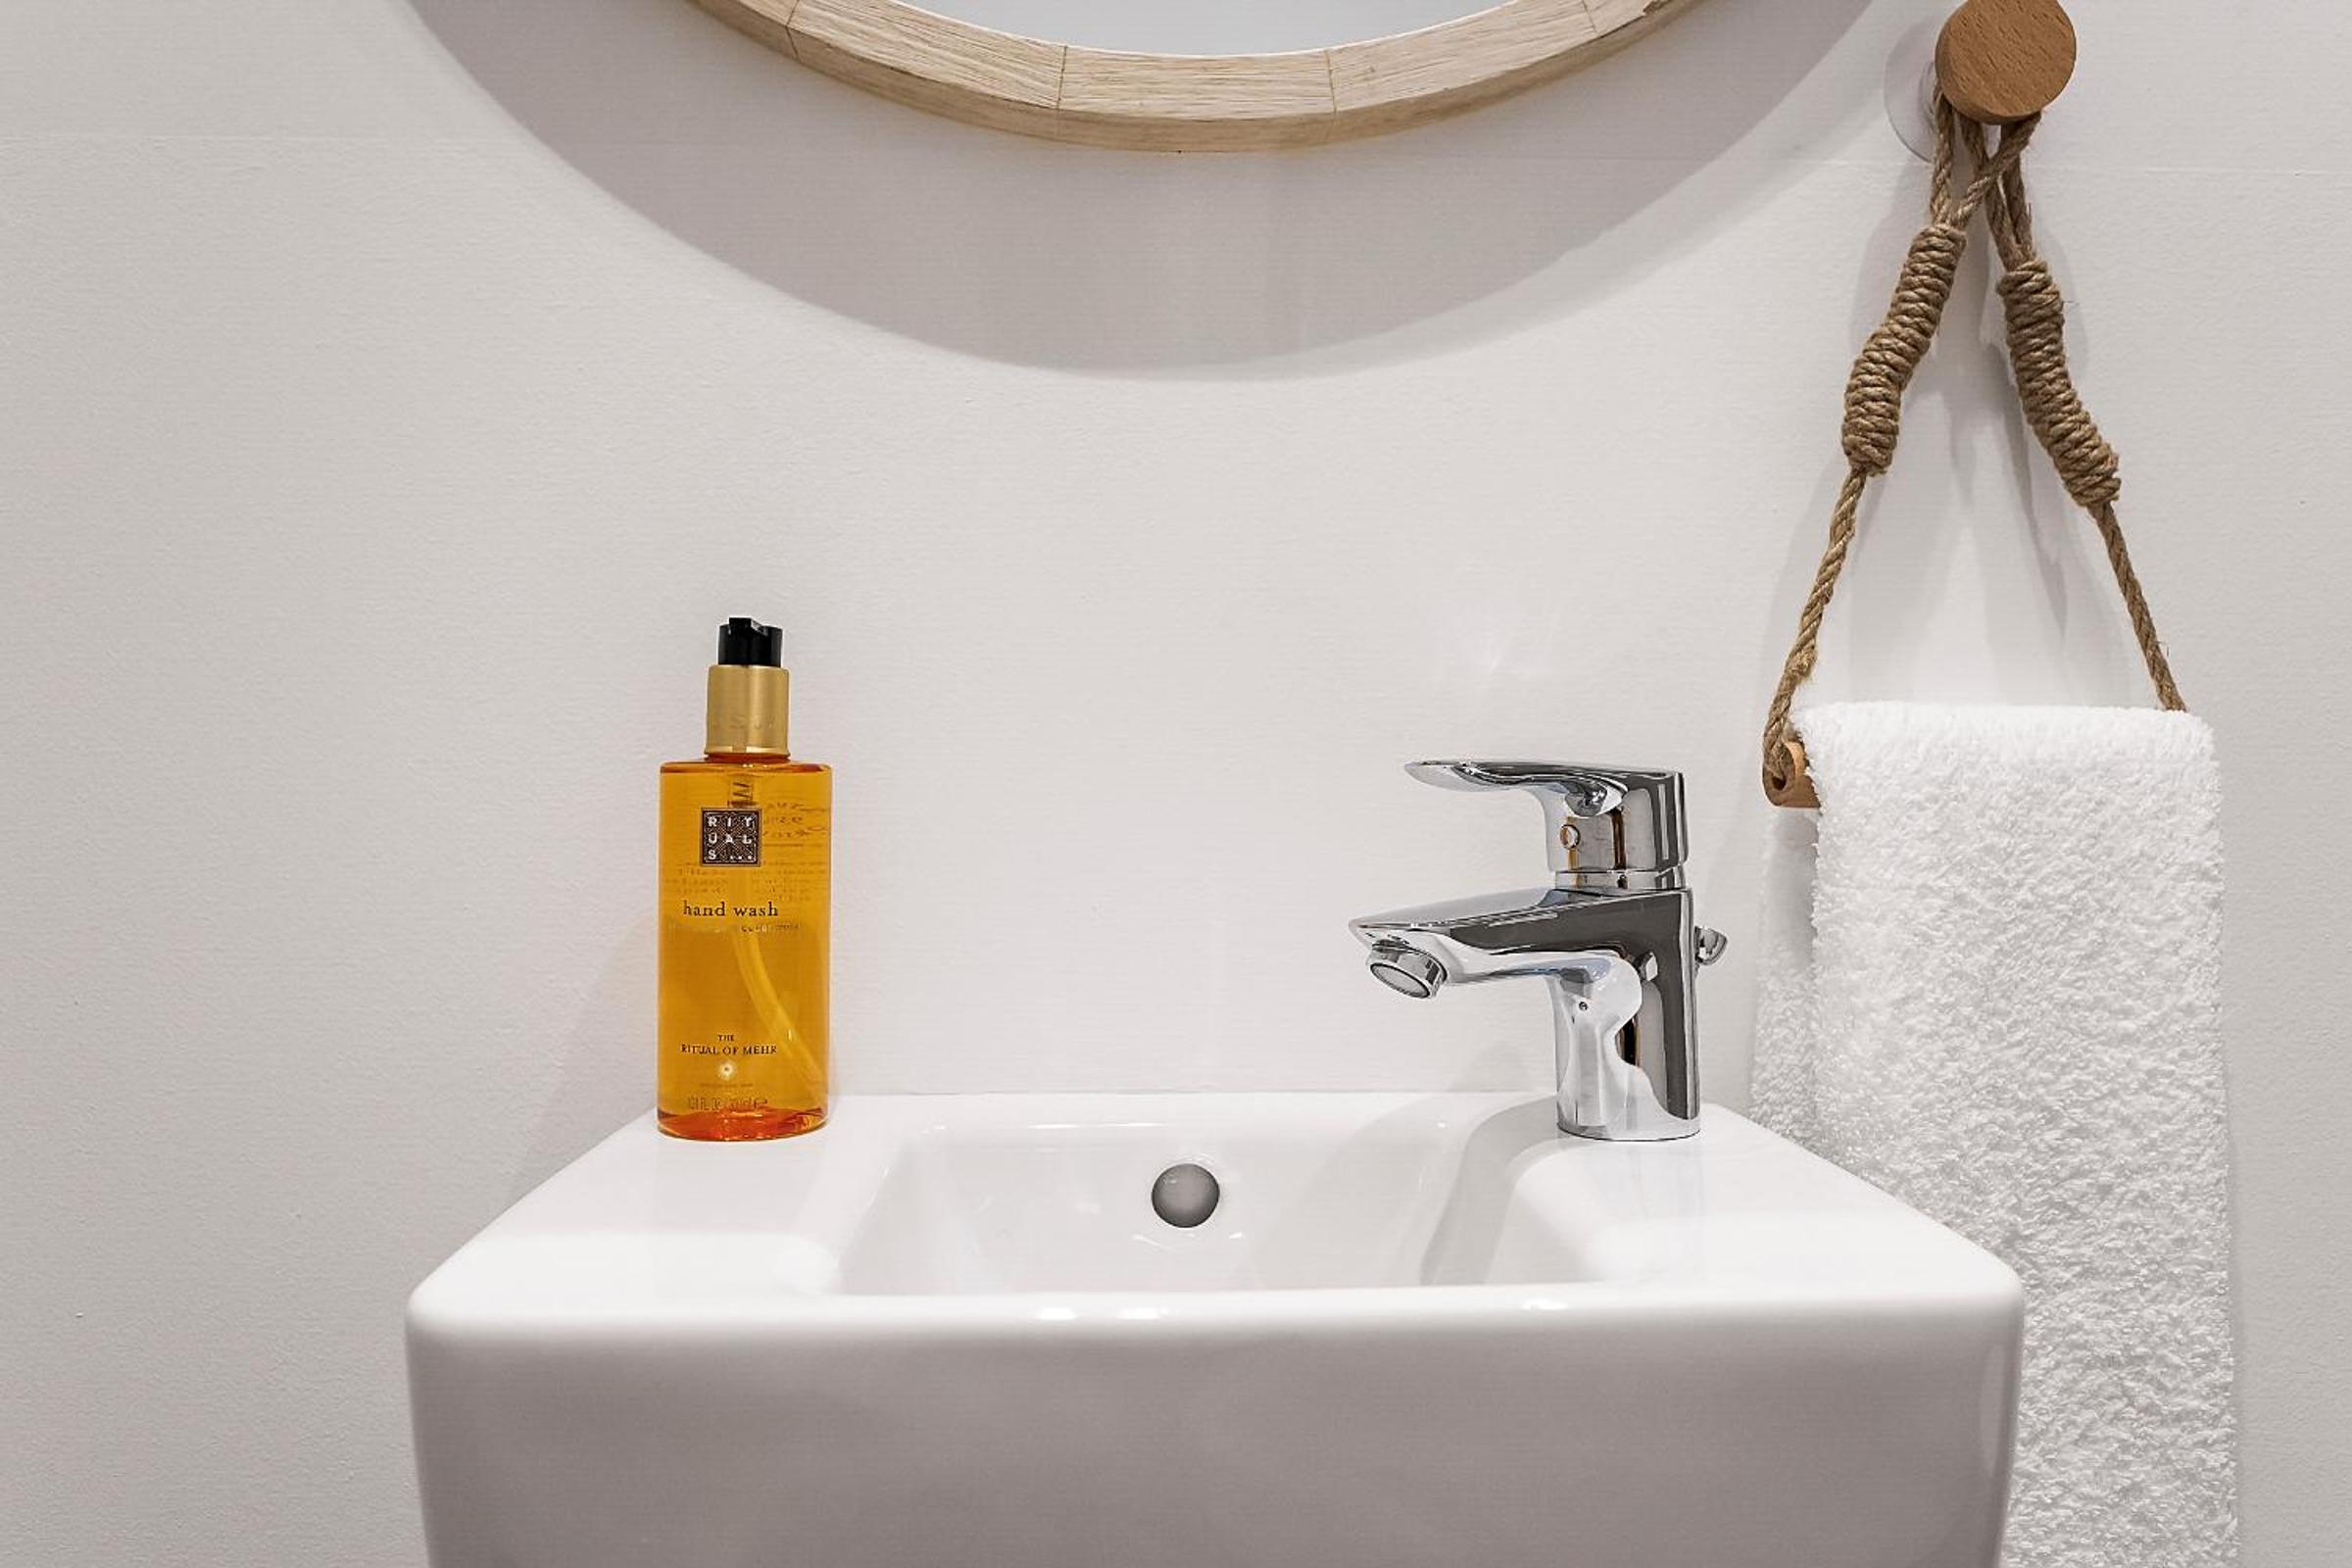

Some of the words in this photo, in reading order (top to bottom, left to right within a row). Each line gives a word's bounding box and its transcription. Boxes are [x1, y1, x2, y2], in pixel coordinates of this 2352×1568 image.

[682, 900, 726, 917] hand
[734, 901, 778, 917] wash
[717, 1034, 735, 1043] THE
[681, 1043, 720, 1055] RITUAL
[721, 1045, 739, 1056] OF
[743, 1044, 777, 1055] MEHR
